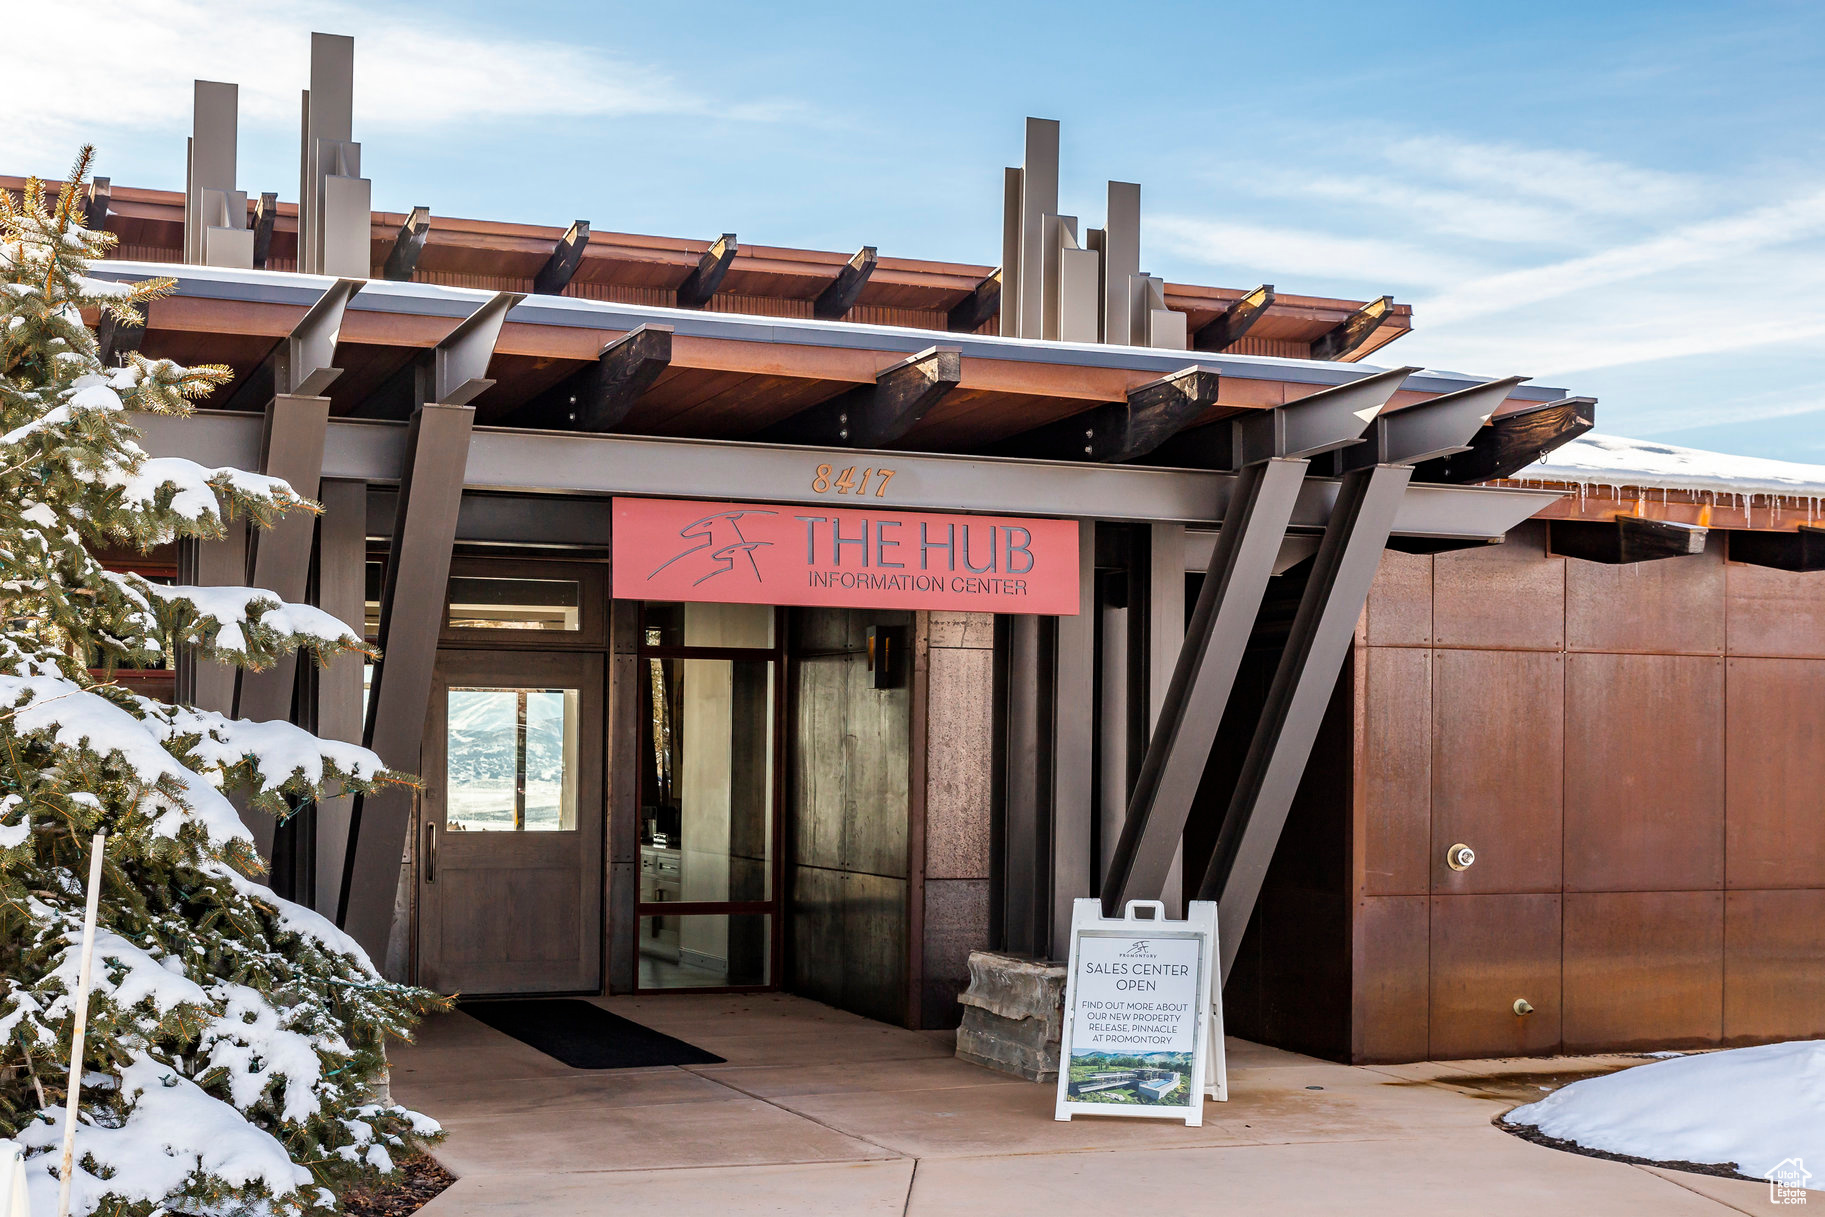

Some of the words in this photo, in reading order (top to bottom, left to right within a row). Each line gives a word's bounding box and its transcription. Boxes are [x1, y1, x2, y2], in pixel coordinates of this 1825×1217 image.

[812, 463, 896, 497] 8417
[794, 516, 905, 568] THE
[920, 521, 1034, 574] HUB
[809, 570, 944, 592] INFORMATION
[951, 576, 1027, 595] CENTER
[1086, 962, 1128, 975] SALES
[1132, 963, 1189, 976] CENTER
[1116, 979, 1156, 991] OPEN
[1082, 1001, 1103, 1009] FIND
[1105, 1001, 1125, 1010] OUT
[1126, 1002, 1154, 1011] MORE
[1156, 1003, 1188, 1012] ABOUT
[1087, 1012, 1107, 1020] OUR
[1109, 1012, 1131, 1021] NEW
[1133, 1013, 1181, 1022] PROPERTY
[1089, 1023, 1130, 1033] RELEASE,
[1132, 1024, 1178, 1033] PINNACLE
[1092, 1034, 1103, 1042] AT
[1105, 1035, 1172, 1044] PROMONTORY
